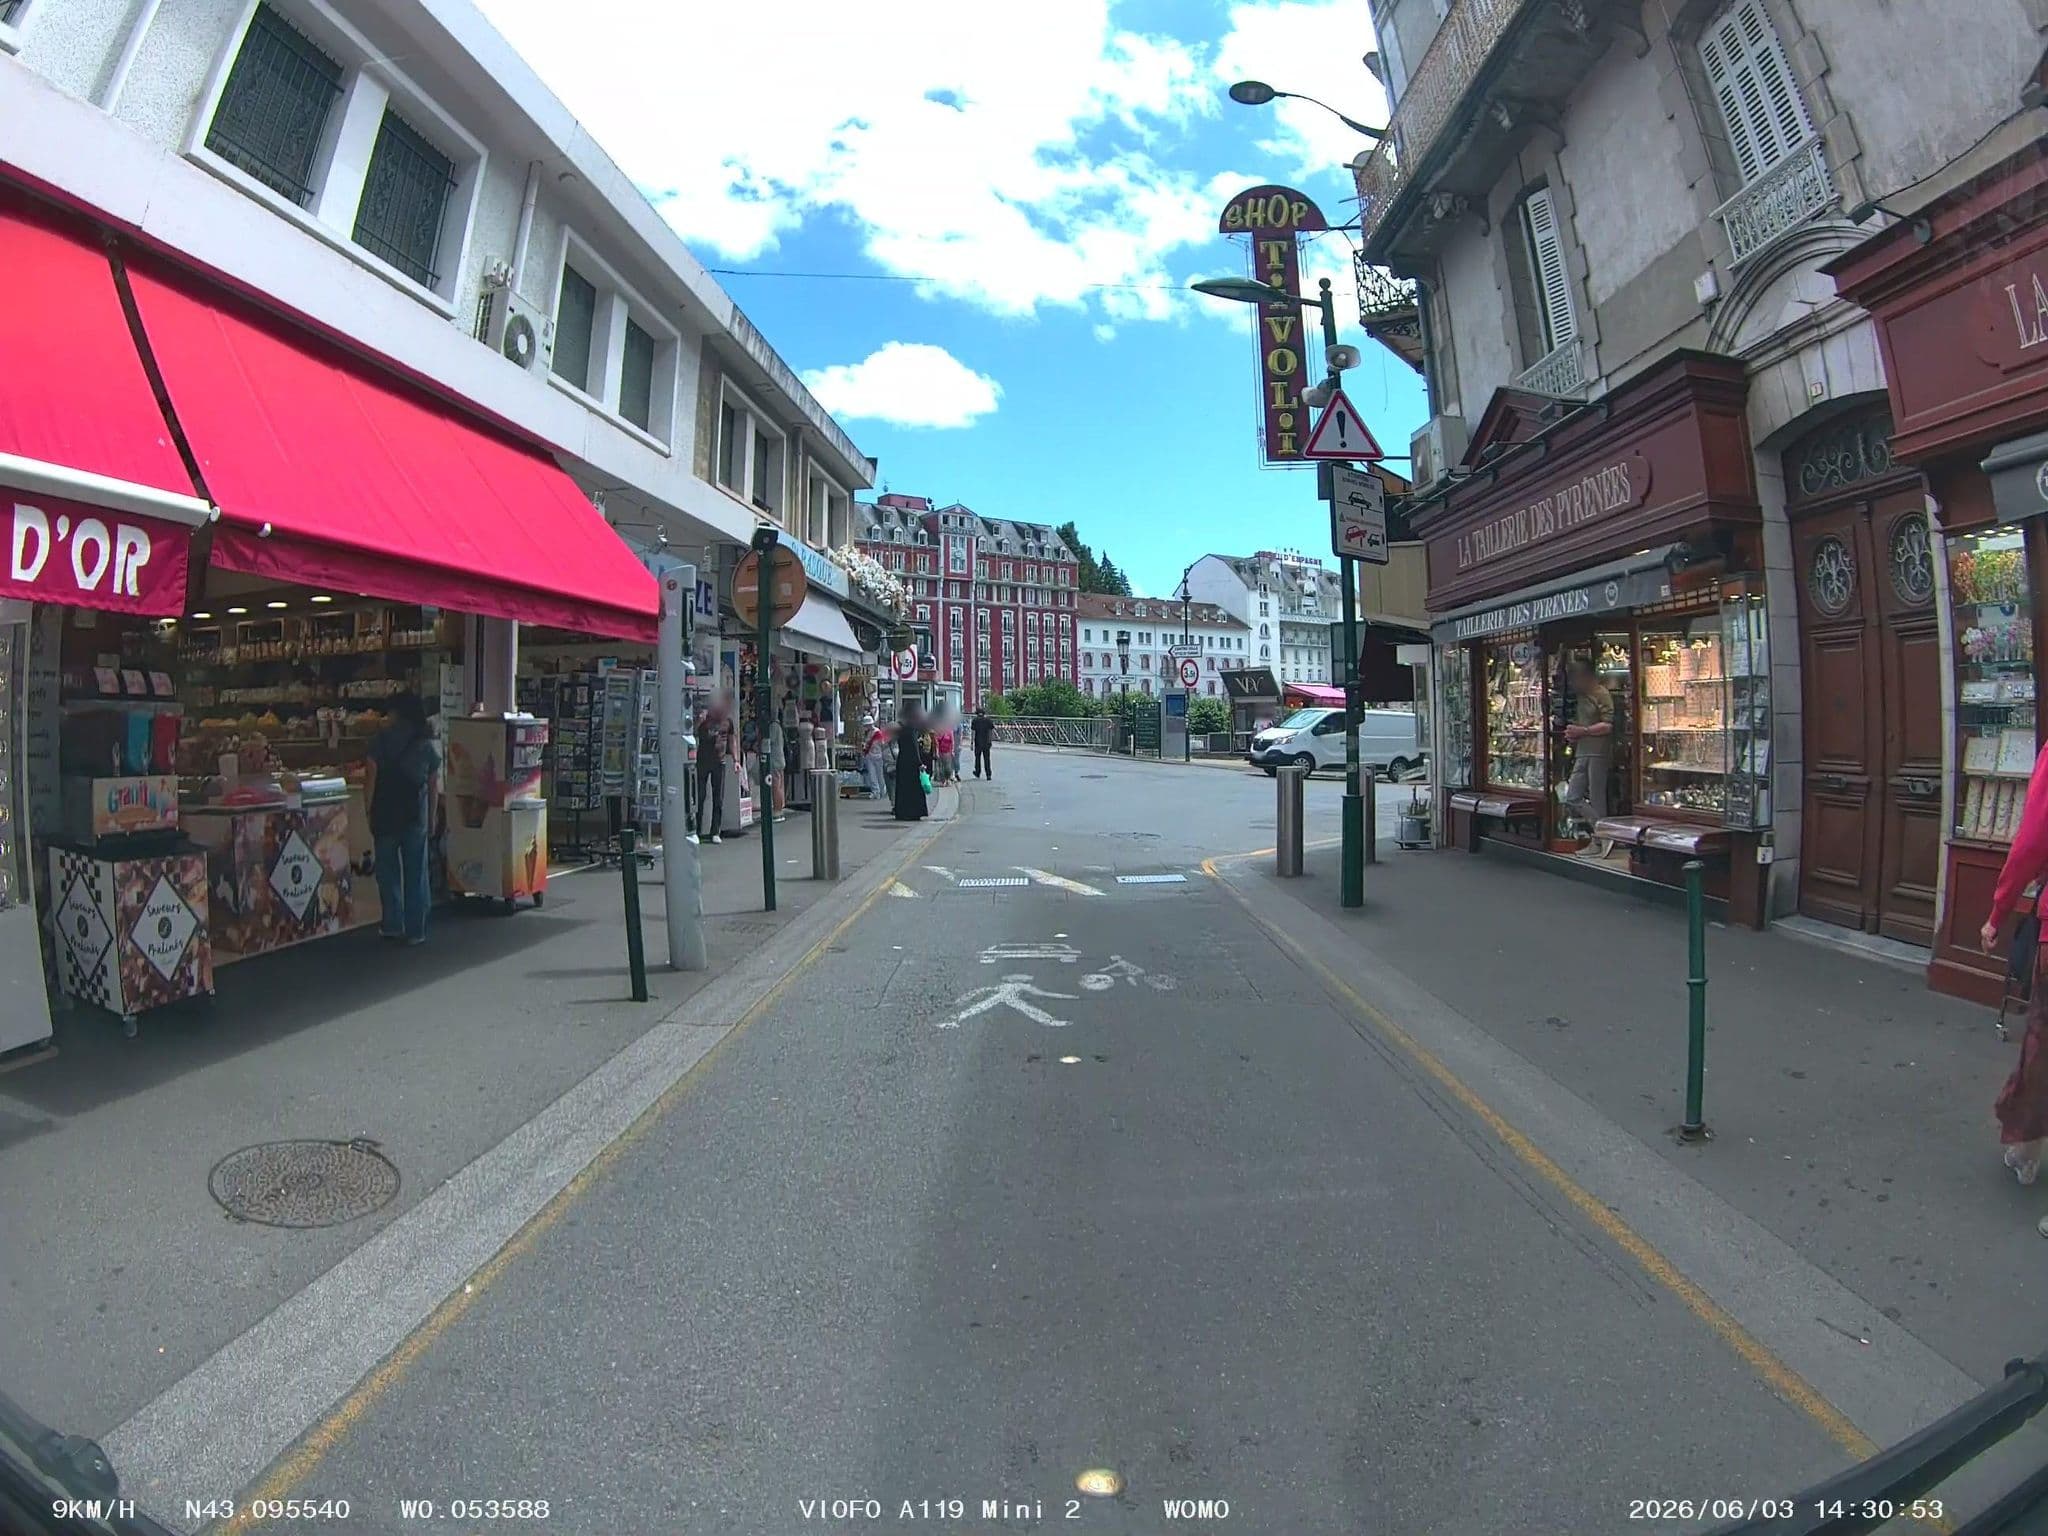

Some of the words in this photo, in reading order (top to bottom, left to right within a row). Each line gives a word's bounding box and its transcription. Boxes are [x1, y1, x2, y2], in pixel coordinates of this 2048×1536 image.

[1225, 194, 1308, 228] SHOP
[11, 502, 151, 596] D'OR
[1458, 538, 1472, 568] LA
[1472, 509, 1528, 561] TAILLERIE
[1530, 497, 1554, 540] DES
[1556, 462, 1632, 529] PYRÉNÉES
[1456, 612, 1504, 638] TAILLERIE
[1508, 603, 1530, 625] DES
[1533, 588, 1590, 618] PYRÉNÉES
